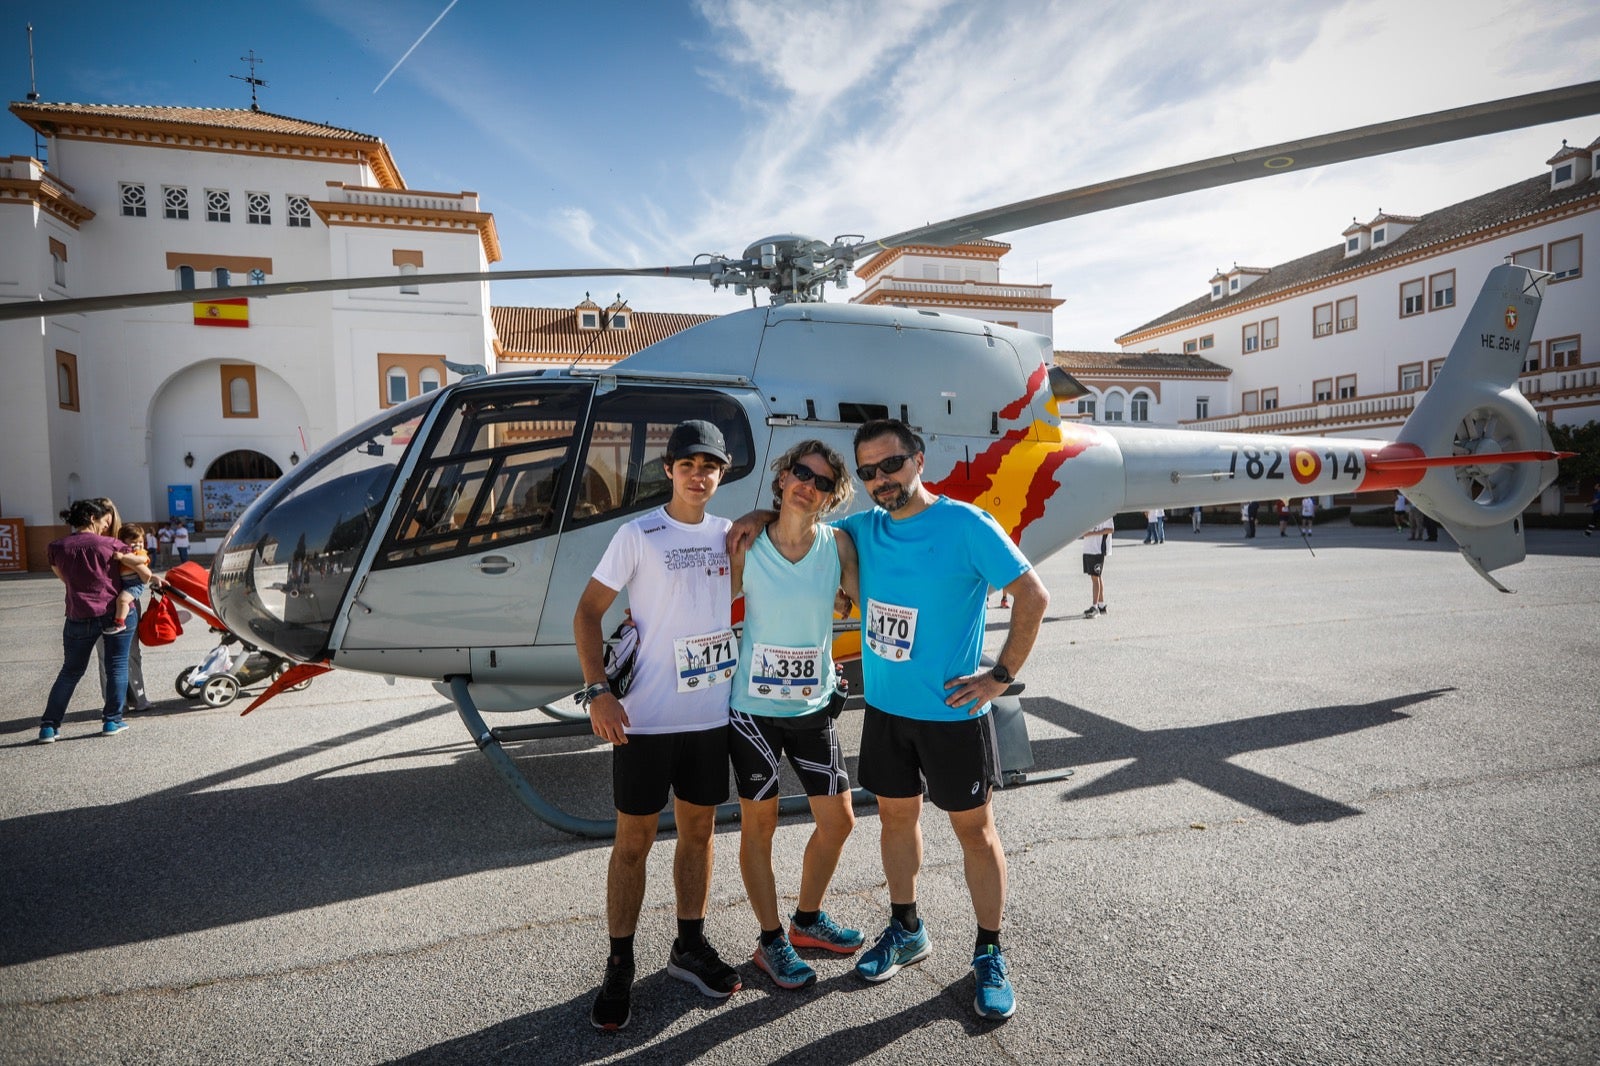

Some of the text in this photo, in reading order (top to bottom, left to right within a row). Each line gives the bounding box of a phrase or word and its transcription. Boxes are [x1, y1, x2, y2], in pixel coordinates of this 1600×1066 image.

[1481, 334, 1520, 353] HE.25-14
[1218, 445, 1361, 480] 782 14
[697, 560, 707, 568] DE
[878, 615, 909, 639] 170
[702, 640, 731, 665] 171
[777, 659, 815, 678] 338
